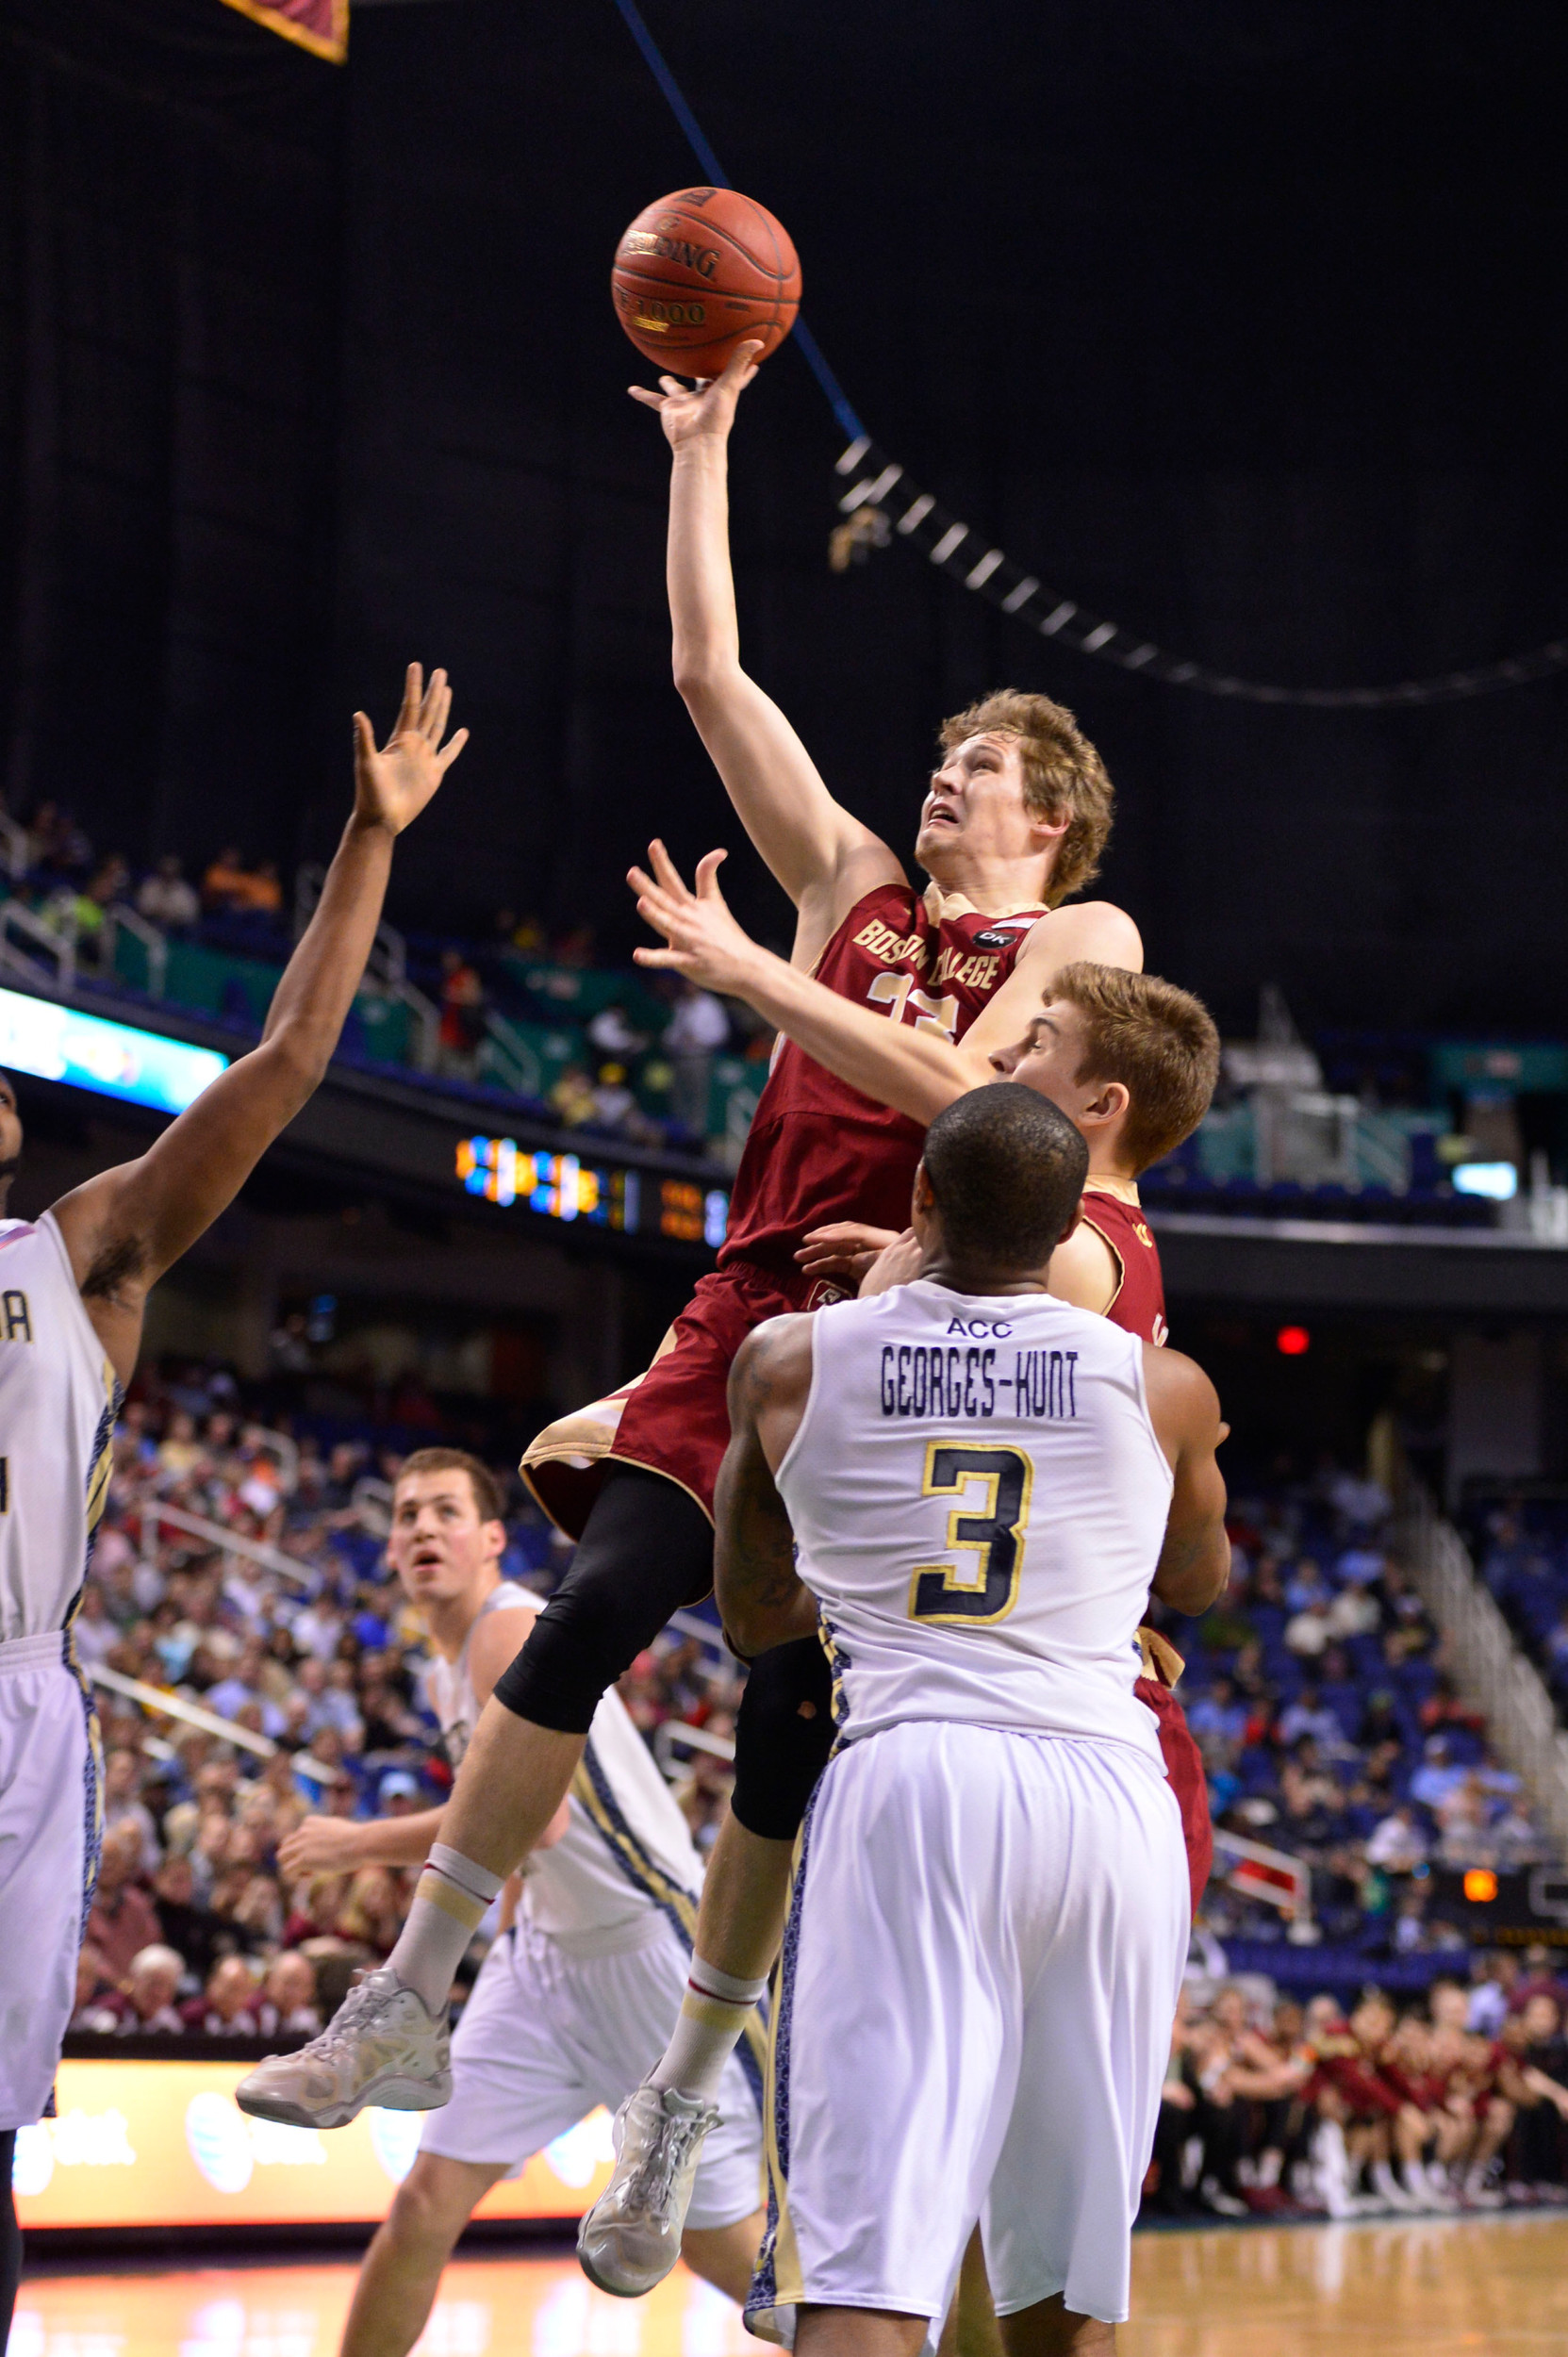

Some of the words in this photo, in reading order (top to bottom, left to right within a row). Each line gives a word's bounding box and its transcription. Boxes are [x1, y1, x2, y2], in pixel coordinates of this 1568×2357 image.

[620, 229, 720, 281] DING
[852, 918, 929, 970] BOSON
[947, 1318, 1013, 1339] ACC
[882, 1346, 1078, 1417] GEORGES-HUNT
[908, 1441, 1034, 1624] 3
